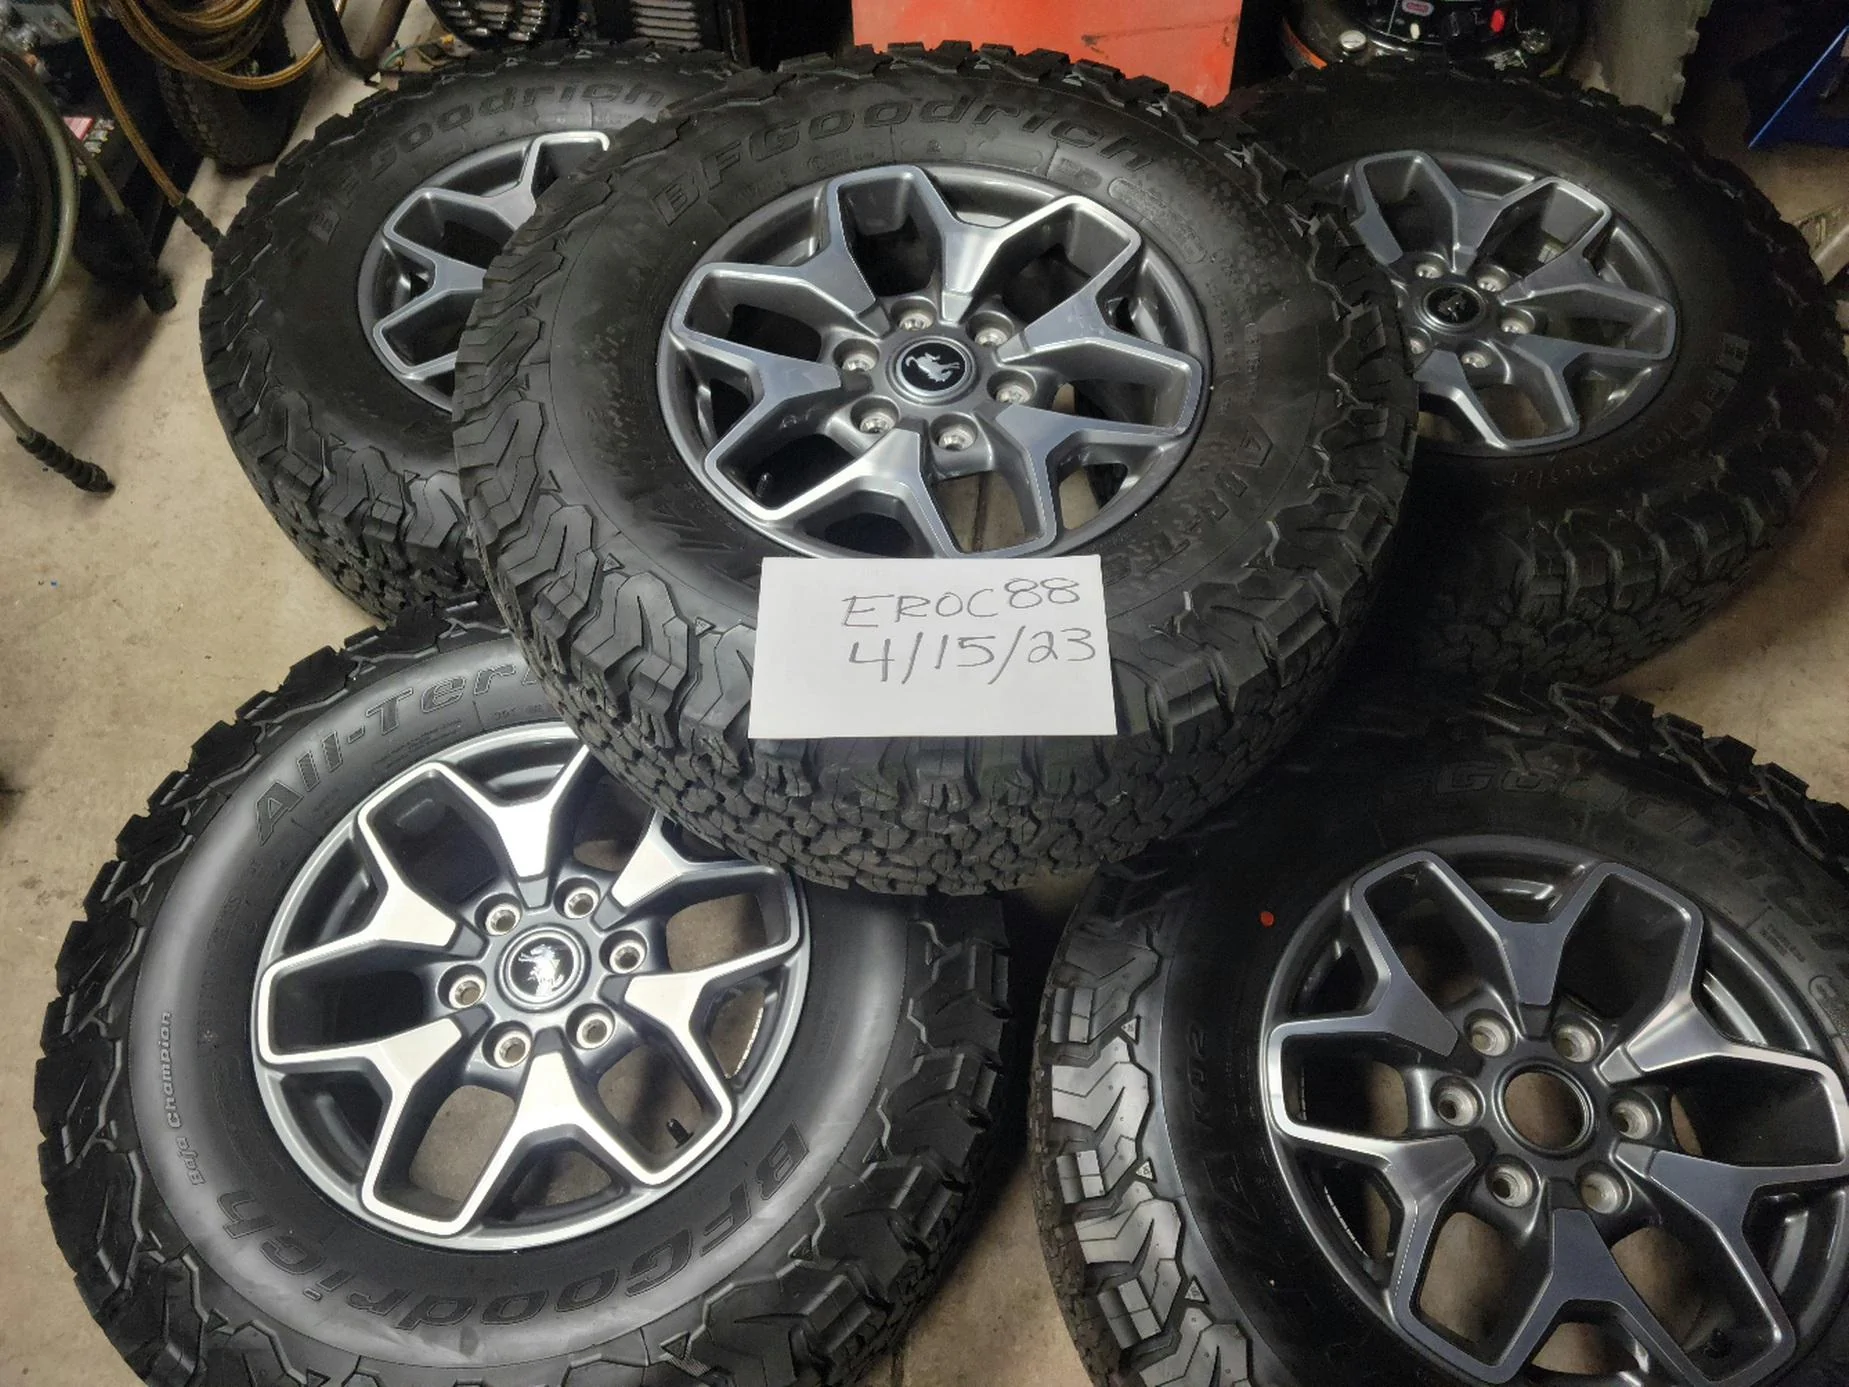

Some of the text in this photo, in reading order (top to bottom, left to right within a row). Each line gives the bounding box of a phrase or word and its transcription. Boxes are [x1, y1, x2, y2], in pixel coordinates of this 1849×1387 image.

[841, 577, 1081, 628] EROC88
[848, 625, 1096, 685] 4/15/23
[159, 1011, 207, 1186] Baja Champion
